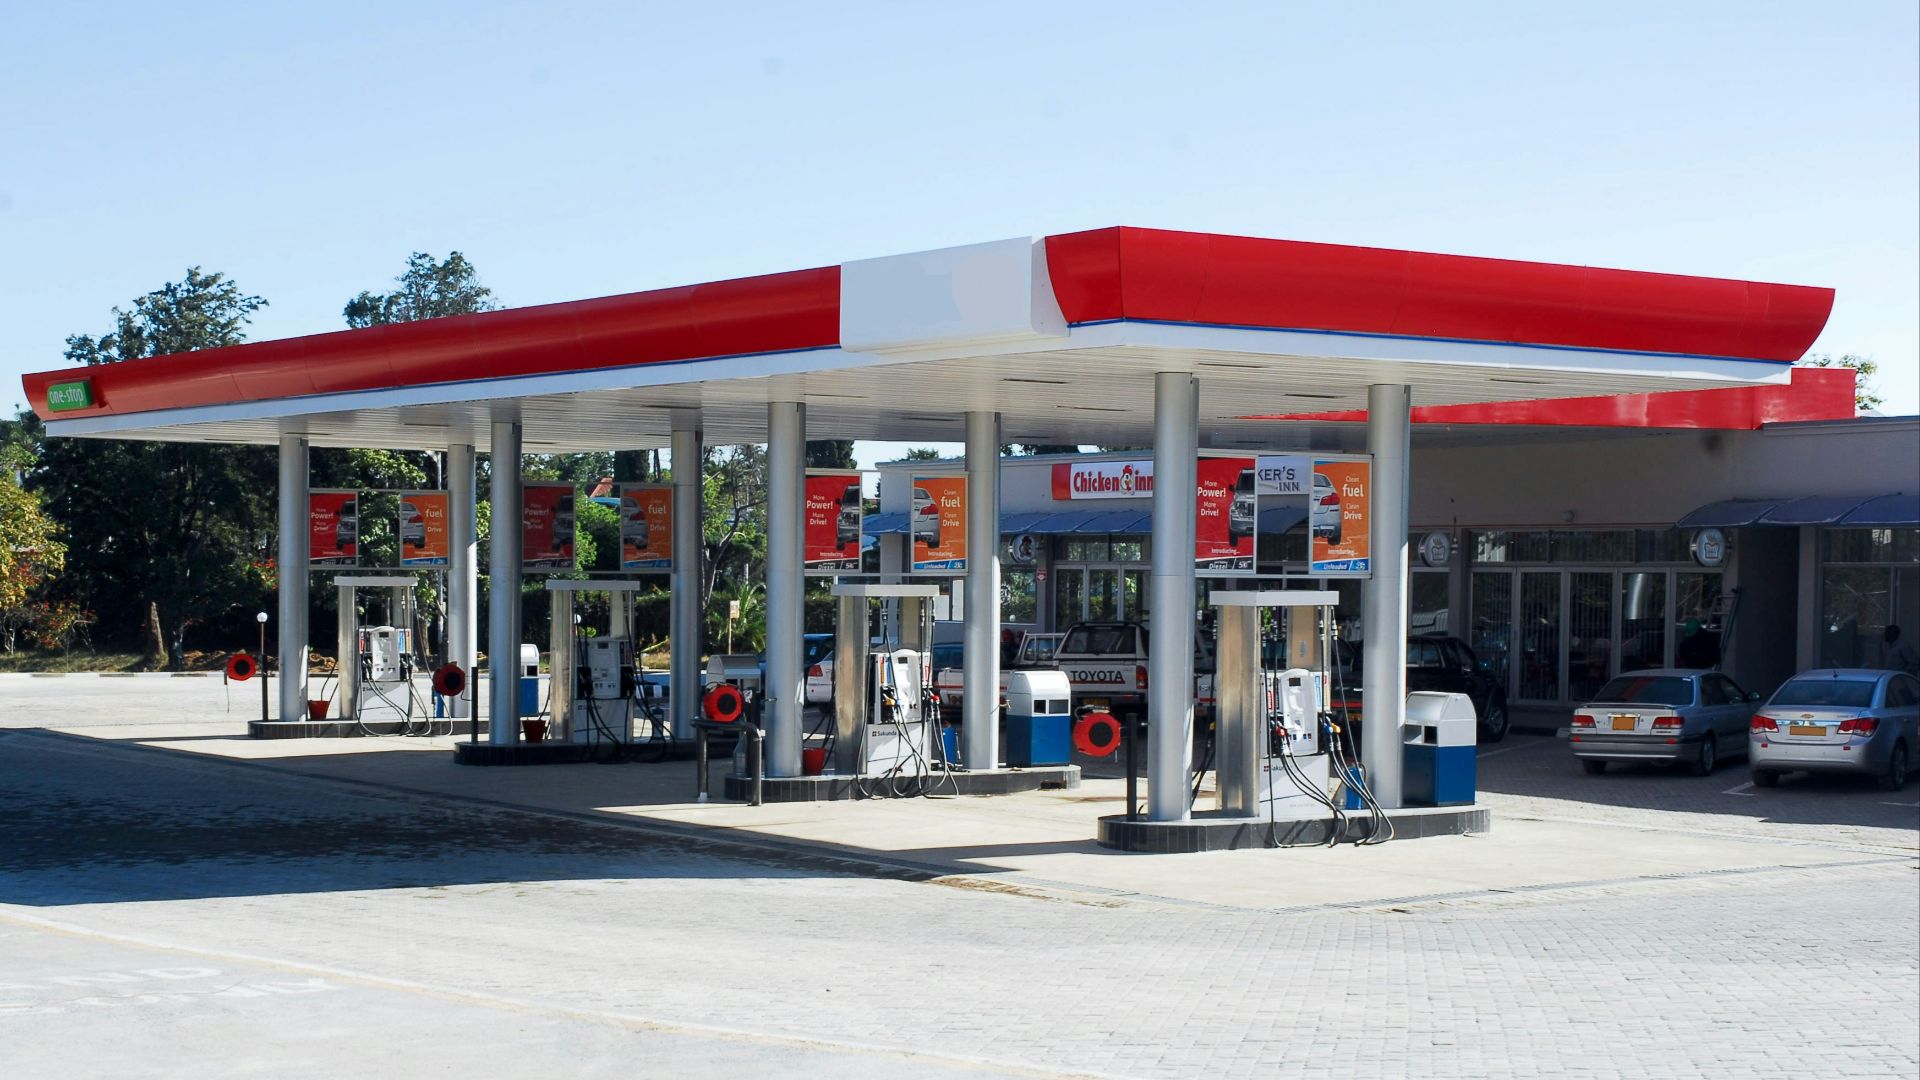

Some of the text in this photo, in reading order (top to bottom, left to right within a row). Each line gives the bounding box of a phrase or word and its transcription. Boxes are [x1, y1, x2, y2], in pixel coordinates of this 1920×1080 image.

[49, 386, 84, 407] one-stop
[1073, 470, 1120, 492] Chicken
[1204, 479, 1218, 487] More
[1345, 475, 1360, 483] Clean
[1278, 481, 1300, 492] INN
[1342, 483, 1364, 498] fuel
[1197, 487, 1227, 498] Power!
[806, 500, 834, 510] Power!
[940, 496, 961, 508] fuel
[1203, 501, 1217, 509] More
[425, 508, 443, 519] fuel
[648, 504, 667, 515] fuel
[1200, 508, 1220, 517] Drive!
[1343, 511, 1363, 520] Drive
[809, 517, 828, 526] Drive!
[942, 519, 960, 527] Drive
[1070, 670, 1124, 681] TOYOTA
